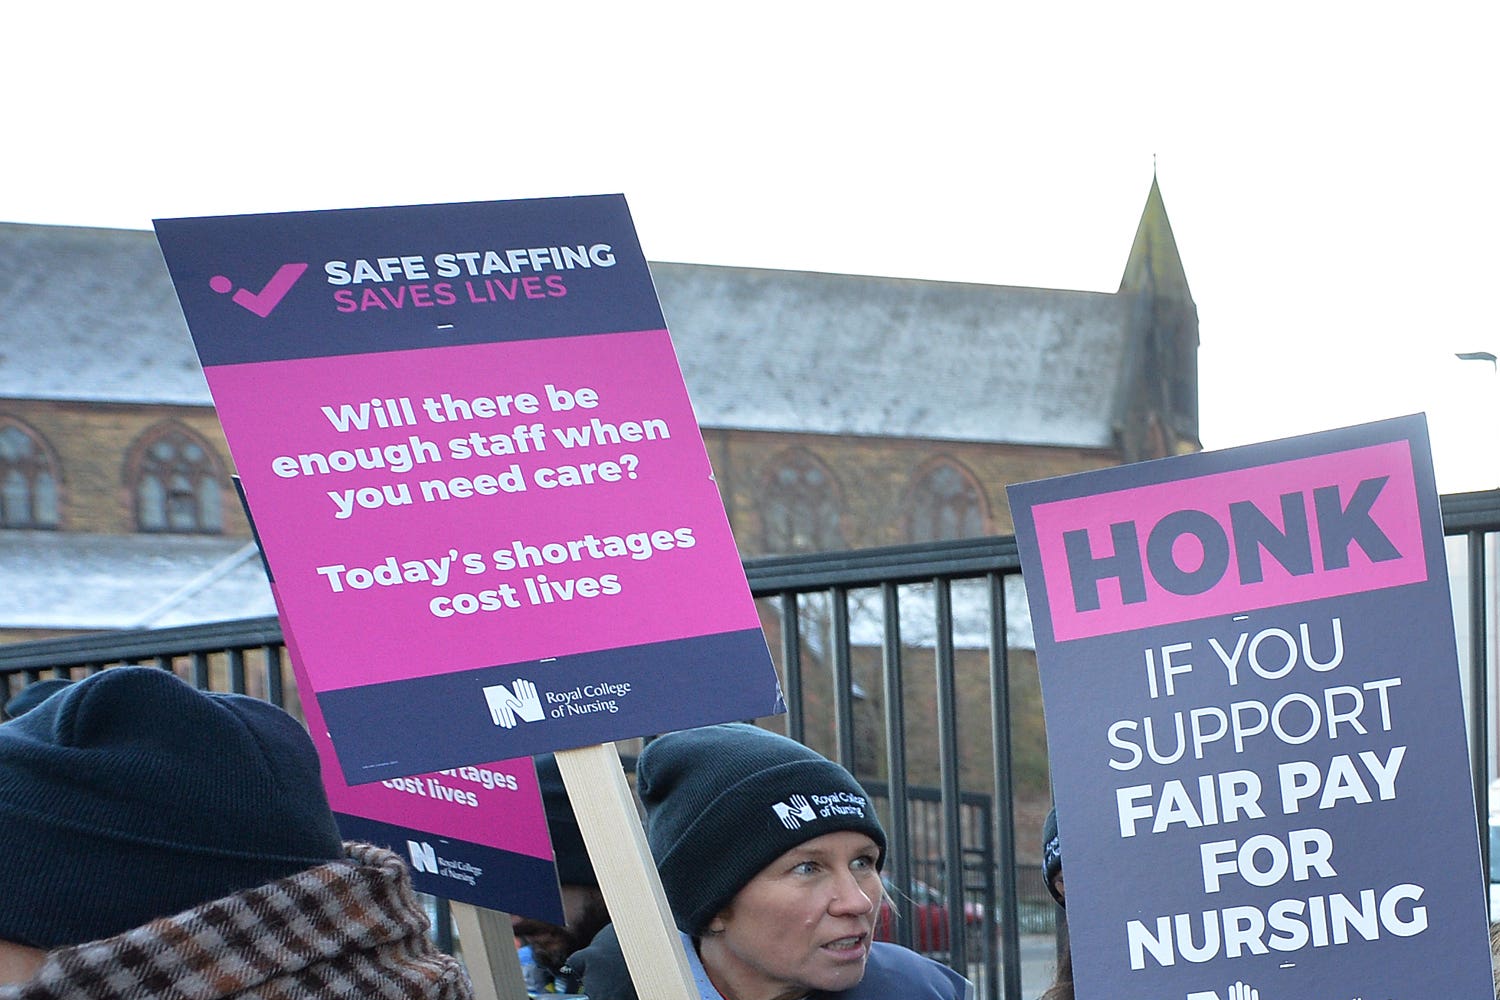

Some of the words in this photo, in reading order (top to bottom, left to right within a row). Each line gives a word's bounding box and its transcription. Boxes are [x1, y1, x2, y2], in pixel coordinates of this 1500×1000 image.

[324, 255, 430, 285] SAFE
[434, 243, 617, 278] STAFFING
[333, 282, 457, 313] SAVES
[465, 275, 568, 304] LIVES
[320, 397, 418, 434] Will
[422, 392, 540, 424] there
[544, 383, 600, 412] be
[271, 435, 442, 479] enough
[447, 423, 547, 461] staff
[554, 417, 672, 450] when
[327, 481, 414, 520] you
[420, 464, 527, 503] need
[532, 453, 640, 490] care?
[316, 548, 487, 594] Today's
[491, 525, 697, 572] shortages
[1062, 474, 1404, 614] HONK
[428, 582, 522, 619] cost
[524, 572, 622, 606] lives
[1144, 642, 1194, 699] IF
[1208, 617, 1345, 687] YOU
[545, 687, 582, 705] Royal
[583, 682, 631, 697] College
[551, 704, 565, 719] of
[567, 699, 619, 716] Nursing
[1106, 677, 1402, 771] SUPPORT
[426, 778, 479, 807] lives
[811, 792, 840, 806] Royal
[820, 805, 831, 817] of
[830, 804, 864, 818] Nursing
[1115, 769, 1266, 838] FAIR
[1277, 745, 1407, 814] PAY
[1200, 828, 1338, 894] FOR
[1125, 883, 1429, 970] NURSING
